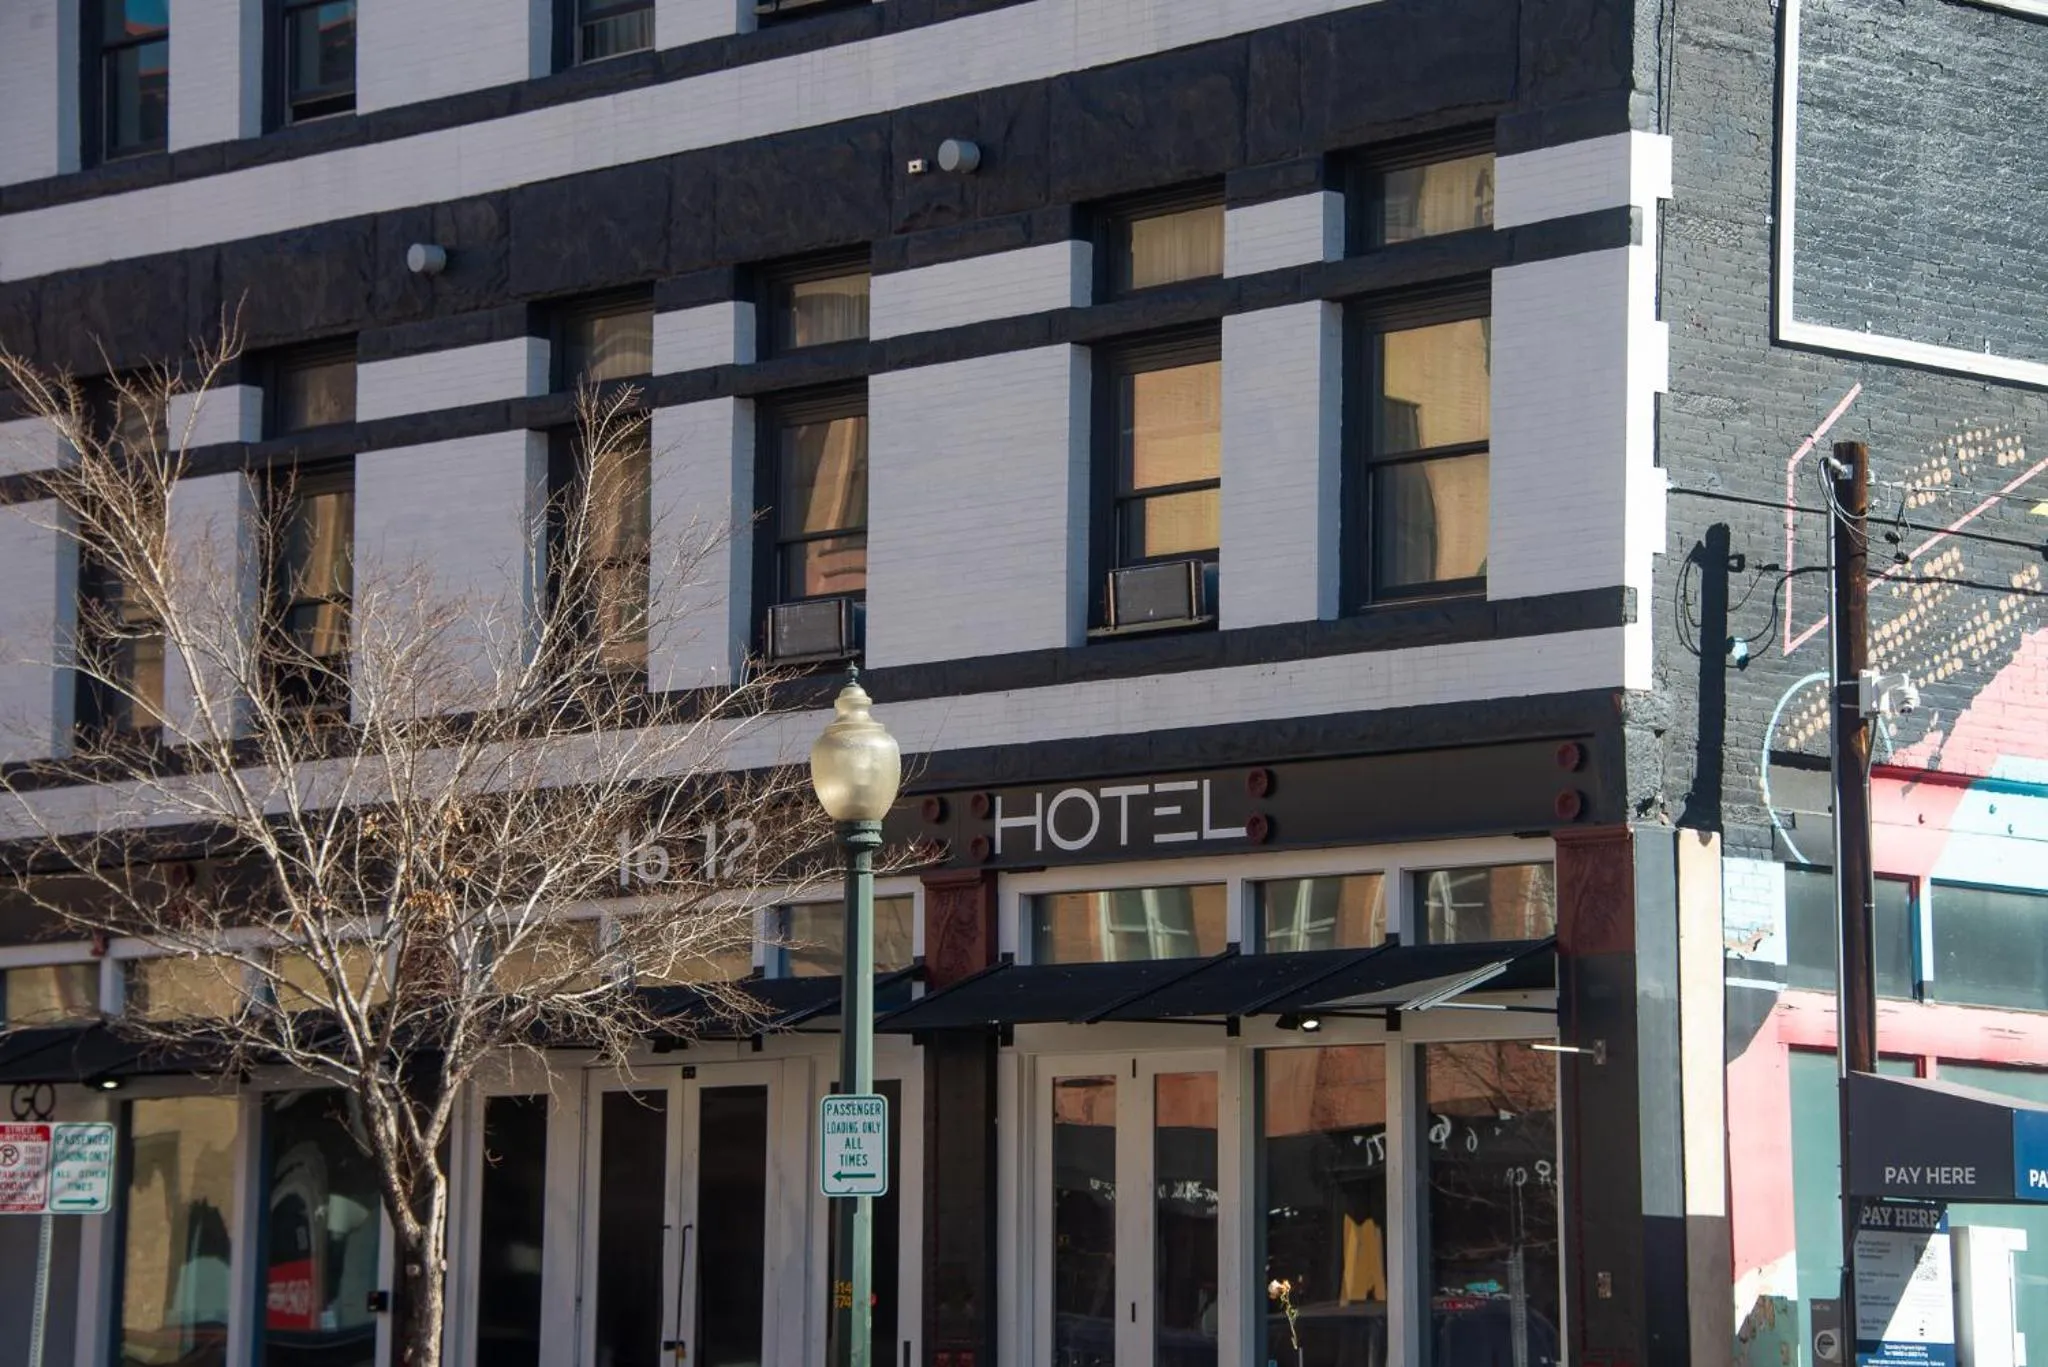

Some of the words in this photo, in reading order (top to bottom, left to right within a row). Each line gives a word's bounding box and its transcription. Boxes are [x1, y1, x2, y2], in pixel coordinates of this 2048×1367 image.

[995, 779, 1247, 855] HOTEL
[826, 1103, 881, 1116] PASSENGER
[826, 1121, 858, 1134] LOADING
[862, 1121, 881, 1134] ONLY
[844, 1137, 864, 1149] ALL
[840, 1154, 868, 1166] TIMES
[1884, 1166, 1921, 1184] PAY
[1926, 1166, 1976, 1185] HERE
[2029, 1168, 2048, 1189] PA
[1861, 1206, 1892, 1226] PAY
[1895, 1208, 1941, 1230] HERE
